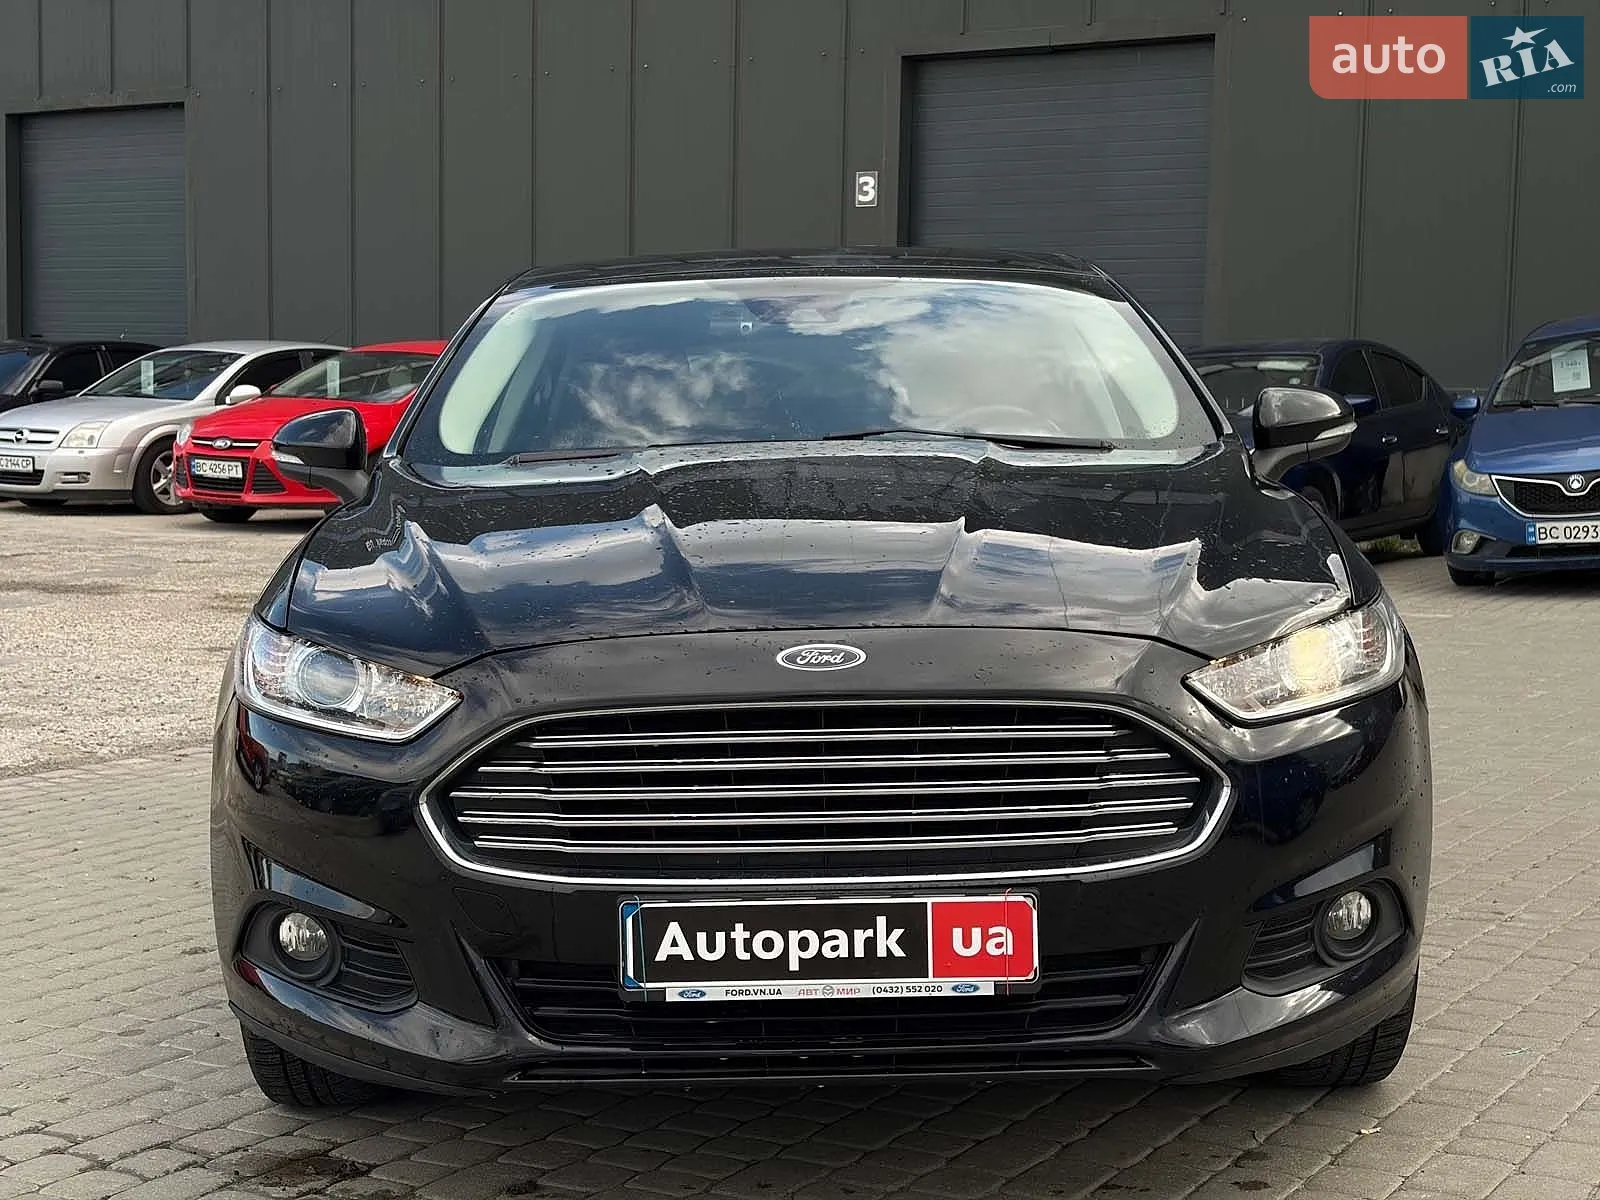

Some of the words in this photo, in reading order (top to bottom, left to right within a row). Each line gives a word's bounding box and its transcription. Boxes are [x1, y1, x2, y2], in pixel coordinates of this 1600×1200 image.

[858, 176, 875, 202] 3
[209, 462, 227, 474] 4256
[1538, 526, 1559, 540] BC
[1563, 525, 1599, 540] 0293
[796, 648, 845, 665] Ford
[654, 915, 907, 972] Autopark
[951, 925, 1014, 957] ua
[725, 988, 783, 997] FORD.VN.UA
[872, 985, 904, 995] (0432)
[905, 985, 923, 994] 552
[924, 984, 943, 993] 020
